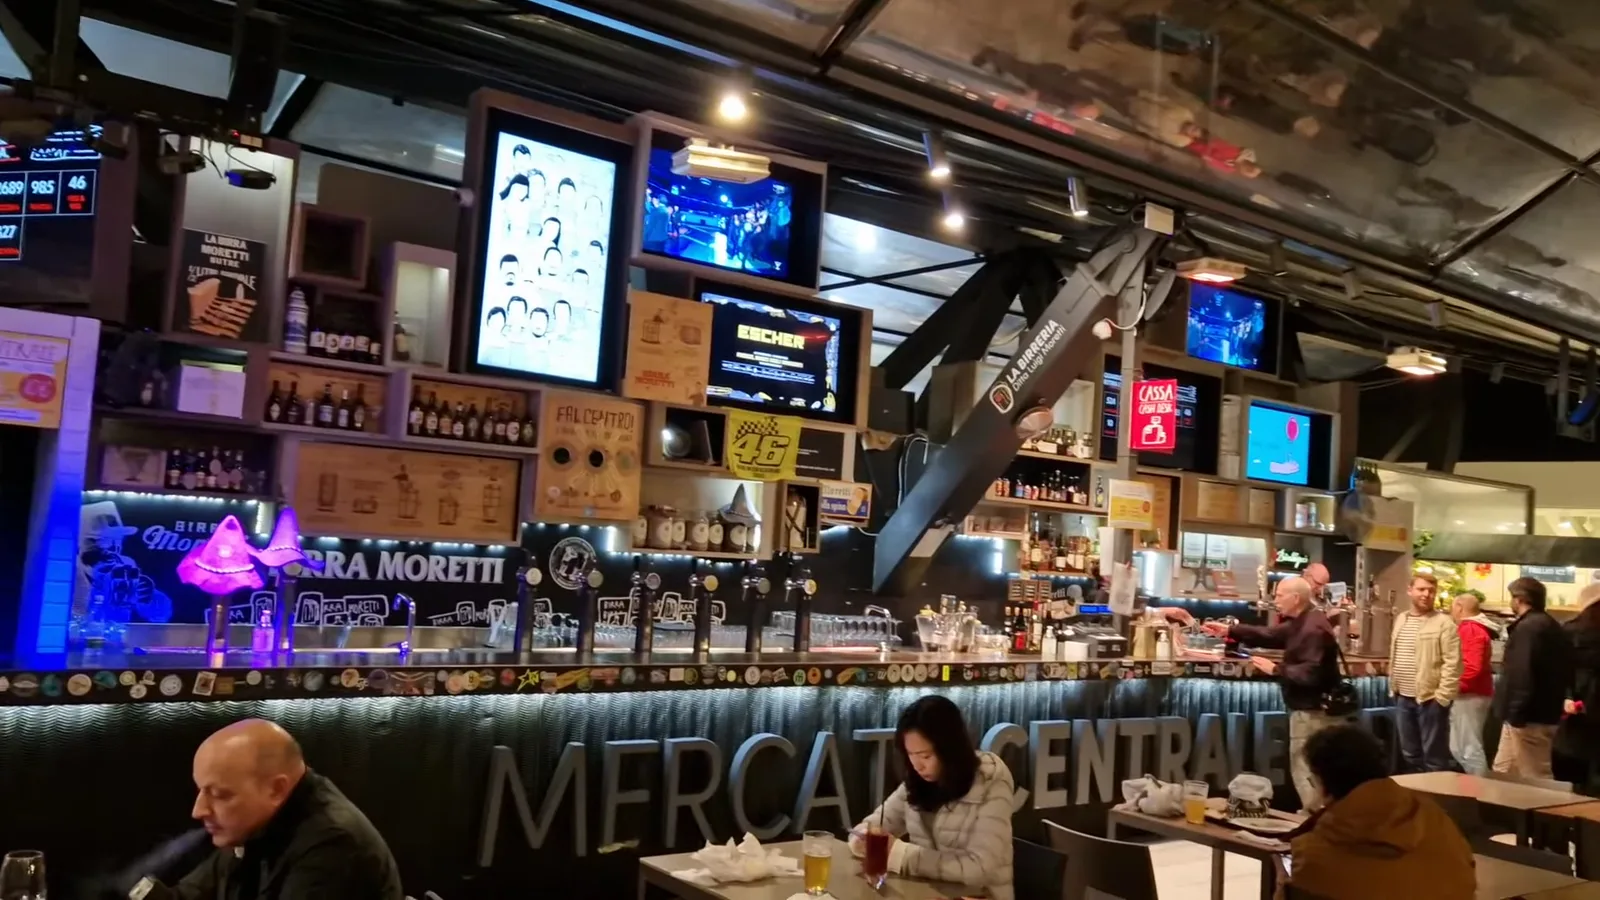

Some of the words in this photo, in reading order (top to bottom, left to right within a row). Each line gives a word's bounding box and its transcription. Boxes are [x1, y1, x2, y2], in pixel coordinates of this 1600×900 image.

[30, 180, 55, 194] 985
[68, 175, 88, 189] 46
[205, 234, 217, 243] LA
[200, 244, 250, 262] MORETTI
[737, 323, 805, 350] ESCHER
[1006, 367, 1021, 384] LA
[1017, 319, 1059, 370] BIRRERIA
[1012, 372, 1029, 392] Ditta
[1027, 352, 1044, 373] Luigi
[1041, 324, 1067, 356] Moretti
[1139, 384, 1173, 402] CASSA
[1139, 403, 1156, 415] CASH
[733, 432, 790, 467] 46
[377, 550, 505, 584] MORETTI
[476, 729, 898, 868] MERCAT
[979, 711, 1288, 812] CENTRALE
